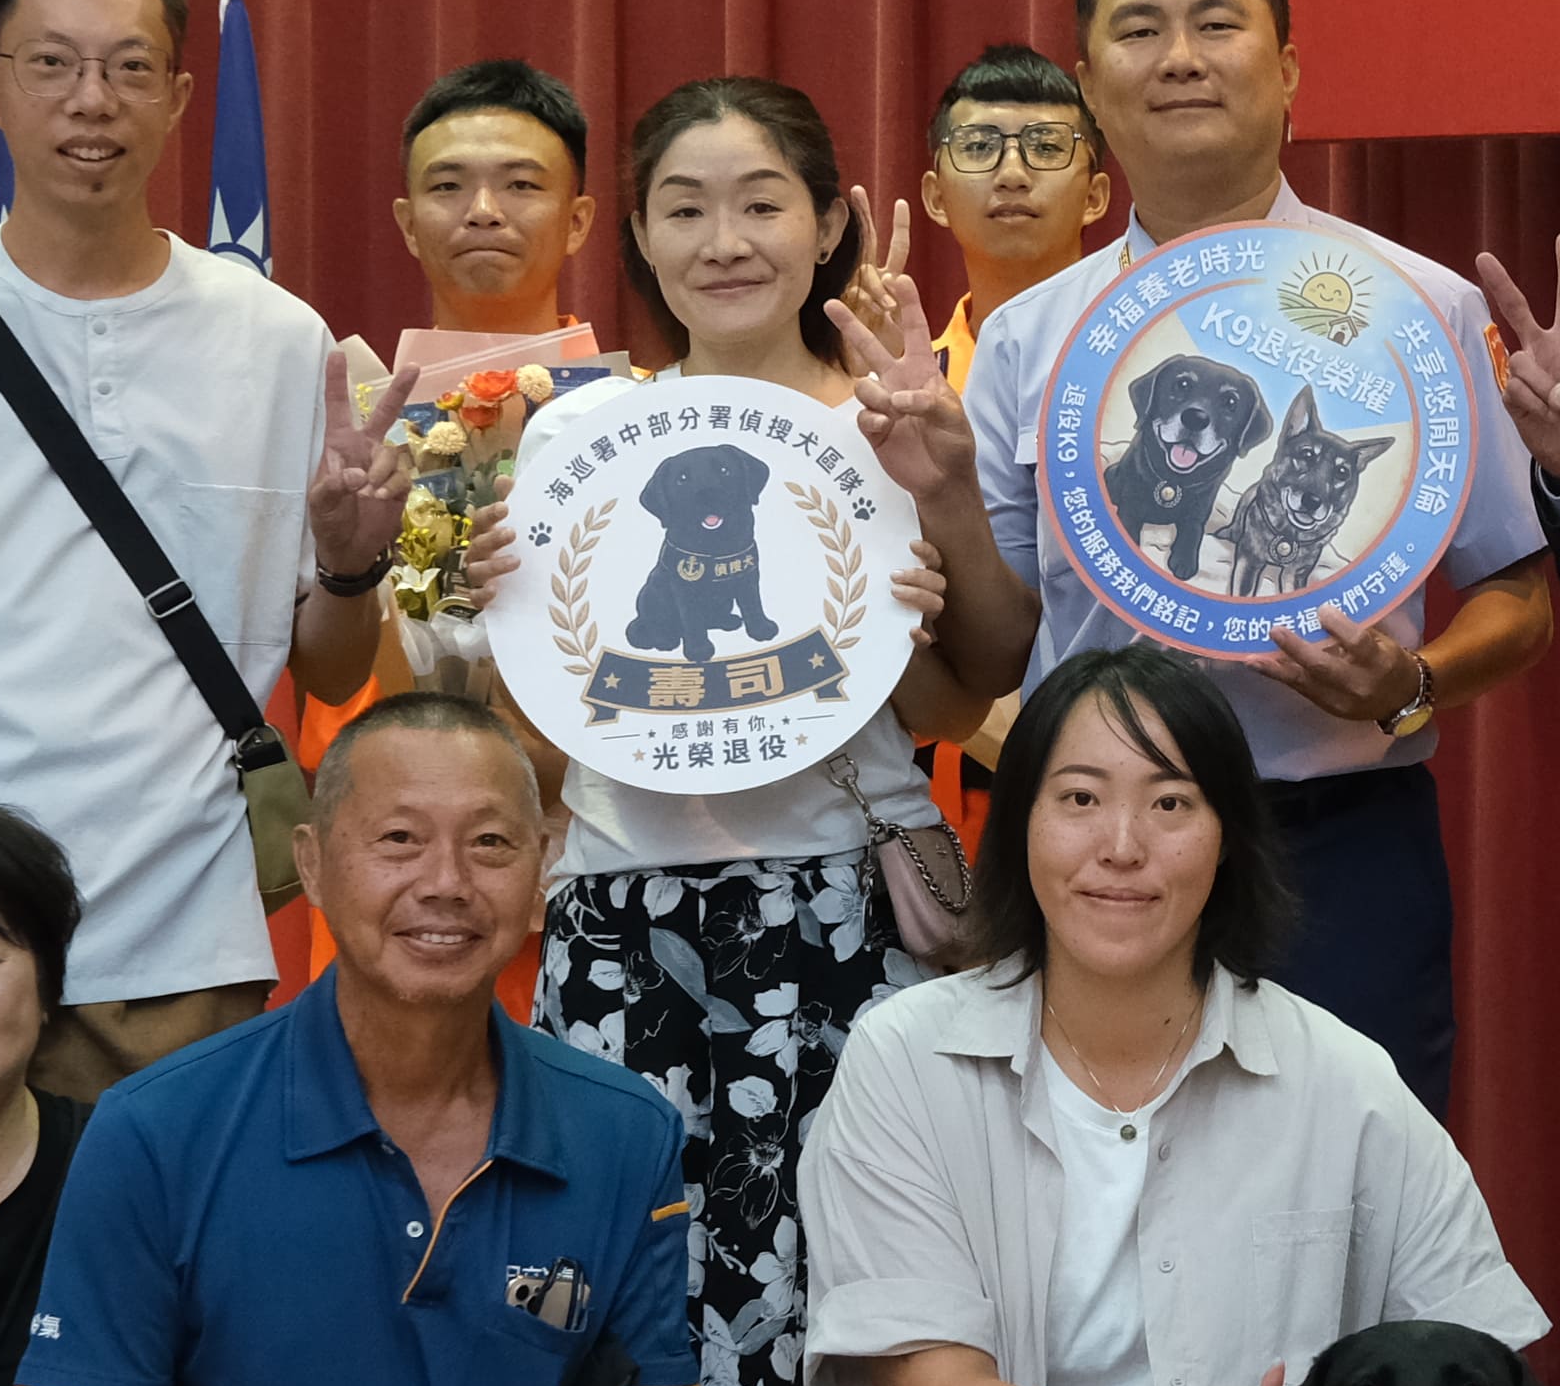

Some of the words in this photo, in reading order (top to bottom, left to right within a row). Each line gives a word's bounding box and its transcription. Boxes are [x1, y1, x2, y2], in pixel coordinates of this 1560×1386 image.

[1086, 237, 1267, 357] 幸福養老時光
[1199, 301, 1397, 417] K9退役榮耀
[543, 404, 866, 507] 海巡署中部分署偵搜犬區隊
[1393, 317, 1460, 516] 共享悠閒天倫
[714, 555, 755, 578] 偵搜犬
[647, 655, 786, 708] 壽司
[652, 734, 788, 772] 光榮退役
